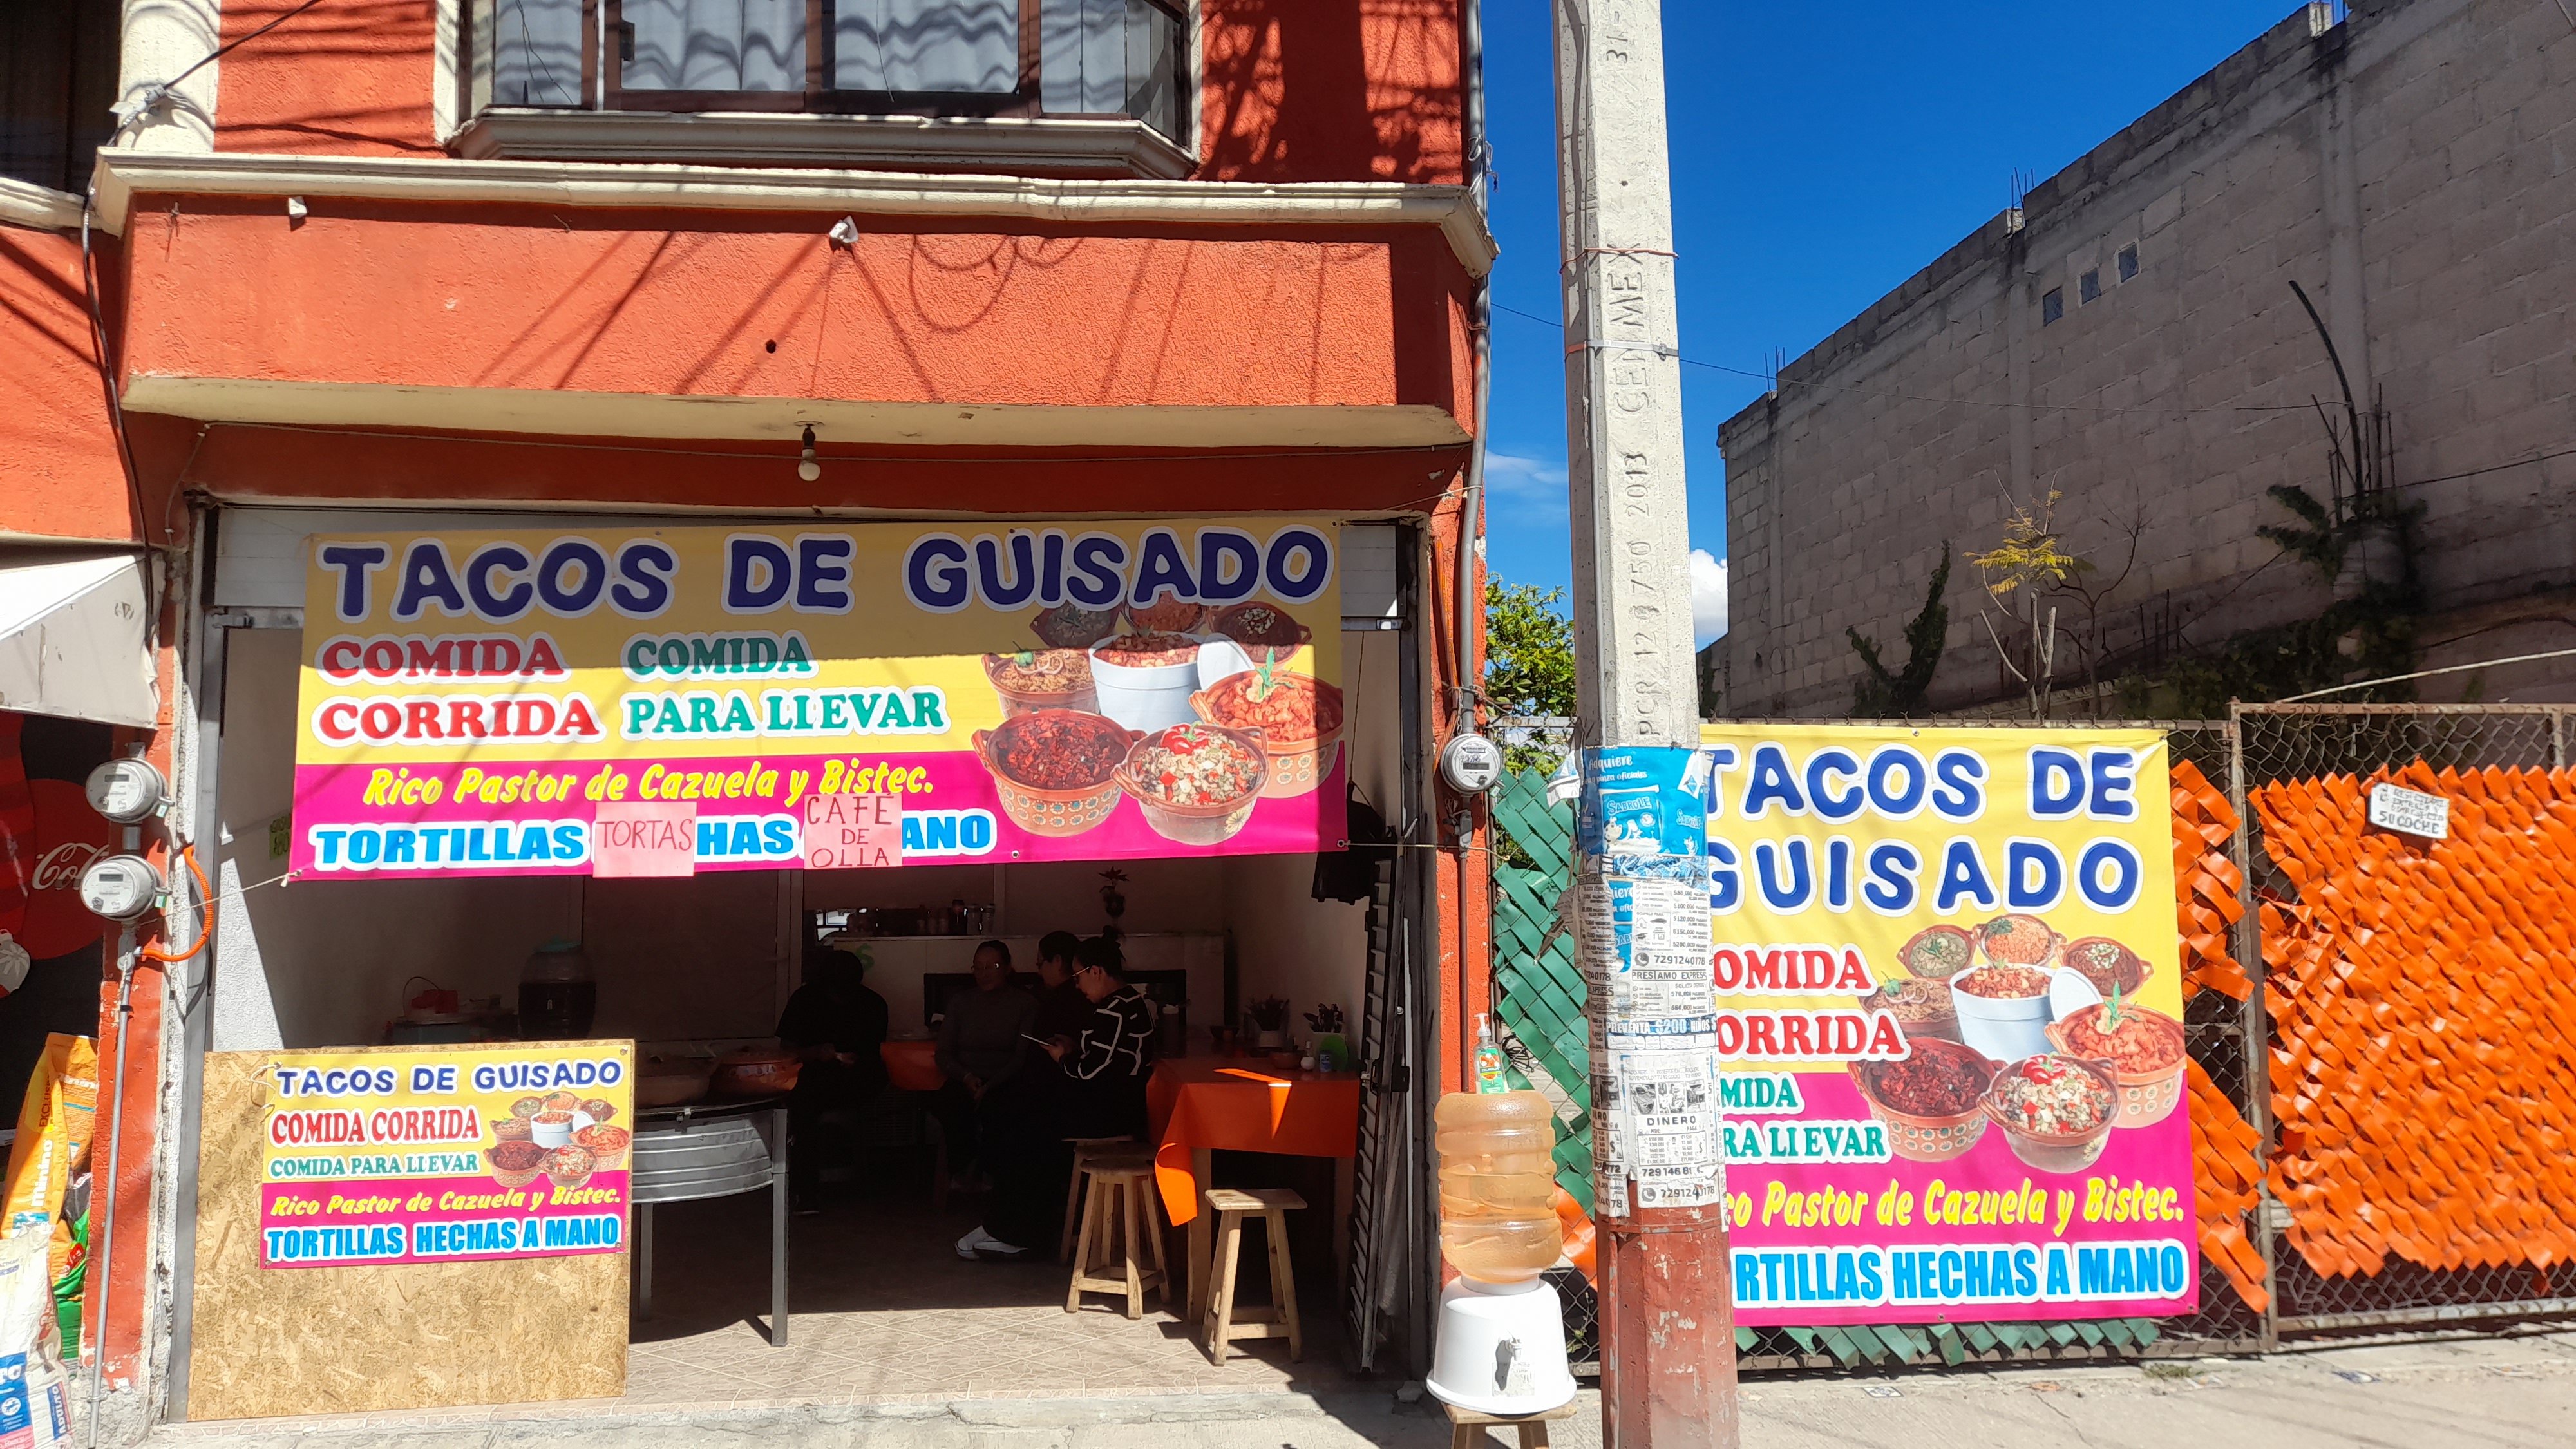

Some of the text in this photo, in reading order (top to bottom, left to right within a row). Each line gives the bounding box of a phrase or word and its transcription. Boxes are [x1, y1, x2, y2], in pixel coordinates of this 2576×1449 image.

[1622, 450, 1650, 518] 2013
[323, 529, 1329, 618] TACOS DE GUISADO
[1627, 540, 1653, 594] 750
[320, 637, 565, 679] COMIDA
[625, 635, 813, 677] COMIDA
[317, 697, 601, 741] CORRIDA
[625, 694, 757, 735] PARA
[362, 757, 934, 808] Rico Pastor de Cazuela y Bistec.
[1588, 754, 1633, 773] Adquiere
[1616, 770, 1648, 781] oficiales
[2031, 749, 2136, 819] DE
[806, 793, 894, 826] CAFÉ
[315, 813, 992, 866] TORTILLAS HAS ANO
[596, 818, 694, 852] TORTAS
[840, 828, 870, 846] DE
[810, 847, 890, 868] OLLA
[1654, 954, 1705, 965] 7291240178
[1713, 949, 1871, 990] OMIDA
[1717, 1014, 1905, 1056] ORRIDA
[276, 1060, 623, 1095] TACOS DE GUISADO
[1721, 1077, 1799, 1109] MIDA
[271, 1108, 480, 1145] COMIDA CORRIDA
[1646, 1115, 1697, 1126] DINERO
[1723, 1126, 1764, 1159] RA
[30, 1138, 54, 1208] minino
[270, 1157, 347, 1178] COMIDA
[350, 1155, 402, 1175] PARA
[1642, 1168, 1662, 1177] 729
[270, 1184, 621, 1217] Rico Pastor de Cazuela y Bistec.
[1761, 1180, 1869, 1227] Pastor
[1875, 1177, 1915, 1227] de
[1924, 1177, 2049, 1226] Cazuela
[2052, 1189, 2076, 1237] y
[2082, 1175, 2184, 1223] Bistec.
[265, 1215, 620, 1260] TORTILLAS HECHAS A MANO
[1734, 1244, 2186, 1303] RTILLAS HECHAS A MANO
[51, 1385, 67, 1435] ADULTO
